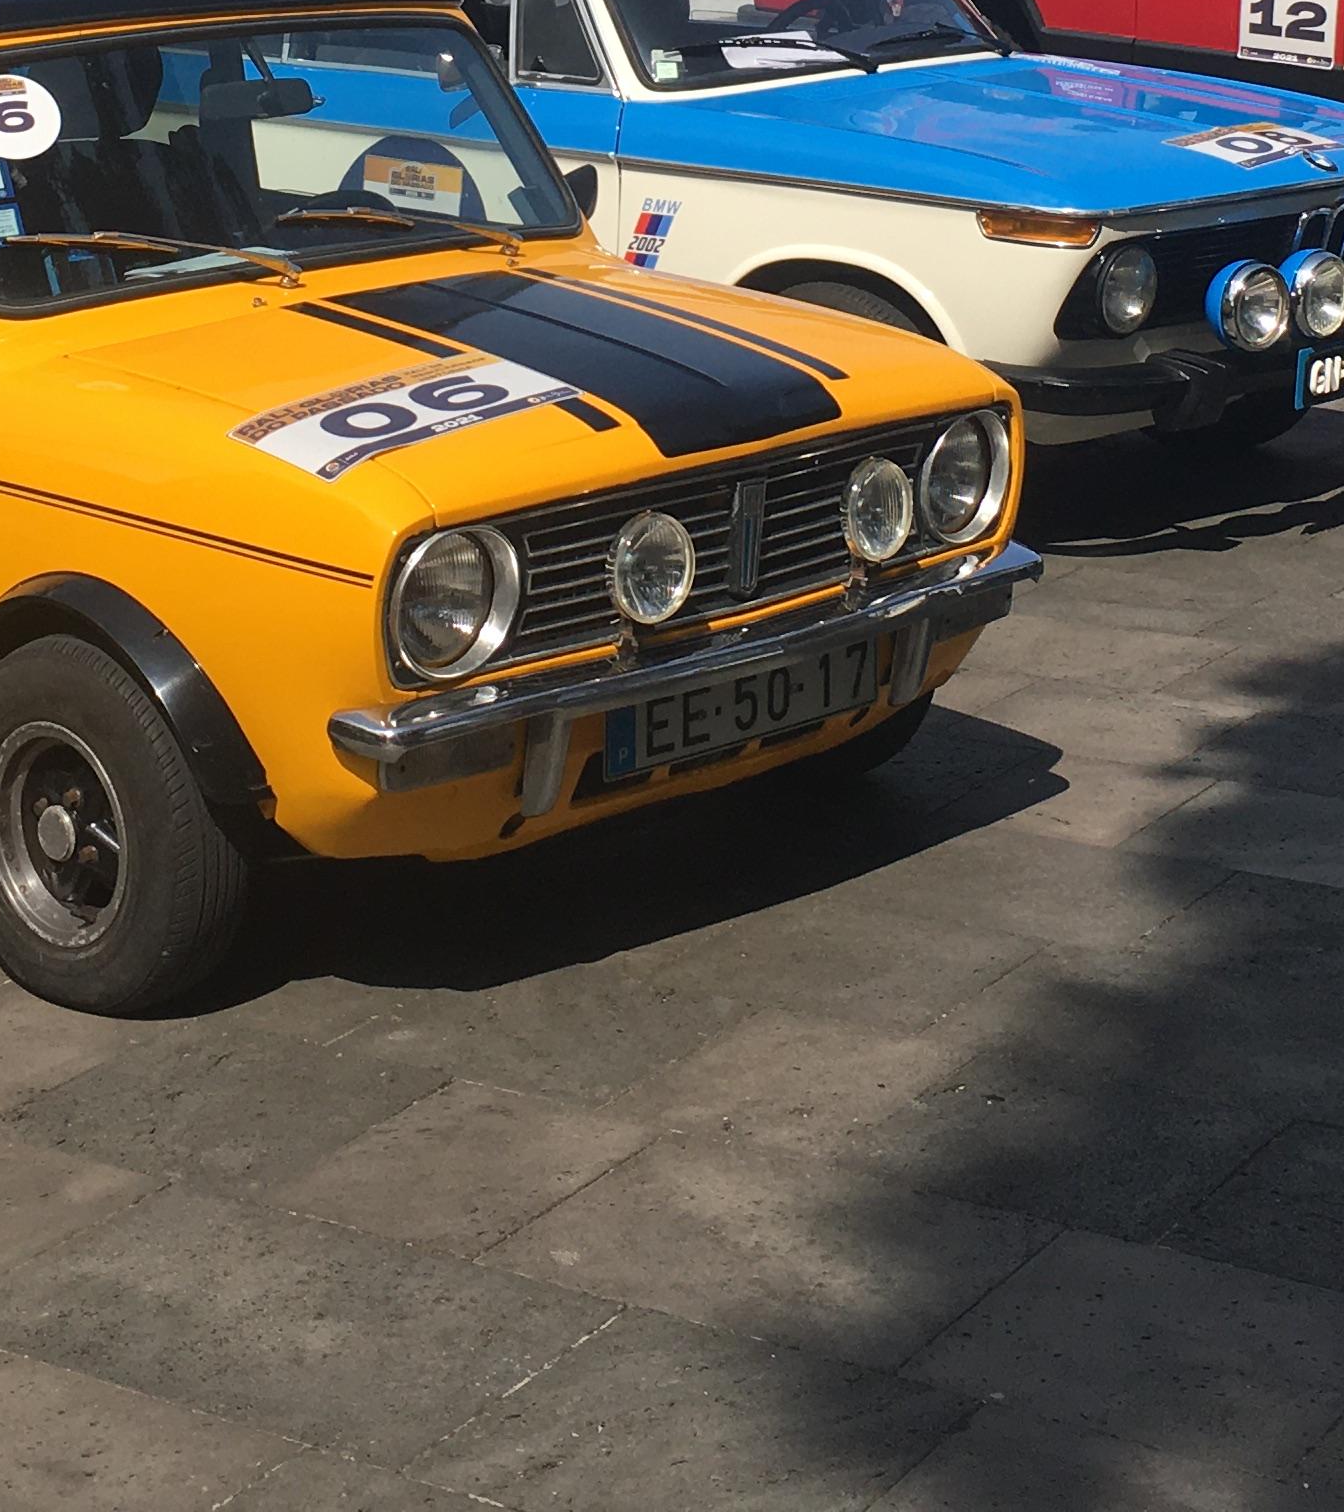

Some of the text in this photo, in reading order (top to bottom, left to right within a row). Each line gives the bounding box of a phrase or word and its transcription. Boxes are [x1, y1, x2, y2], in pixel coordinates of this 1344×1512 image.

[1272, 52, 1298, 63] 2021
[1215, 131, 1313, 154] 08
[642, 198, 682, 214] BMW
[627, 235, 666, 253] 2002
[320, 375, 510, 438] 06
[237, 407, 294, 436] RALI
[248, 420, 289, 440] DO
[430, 414, 484, 433] 2021
